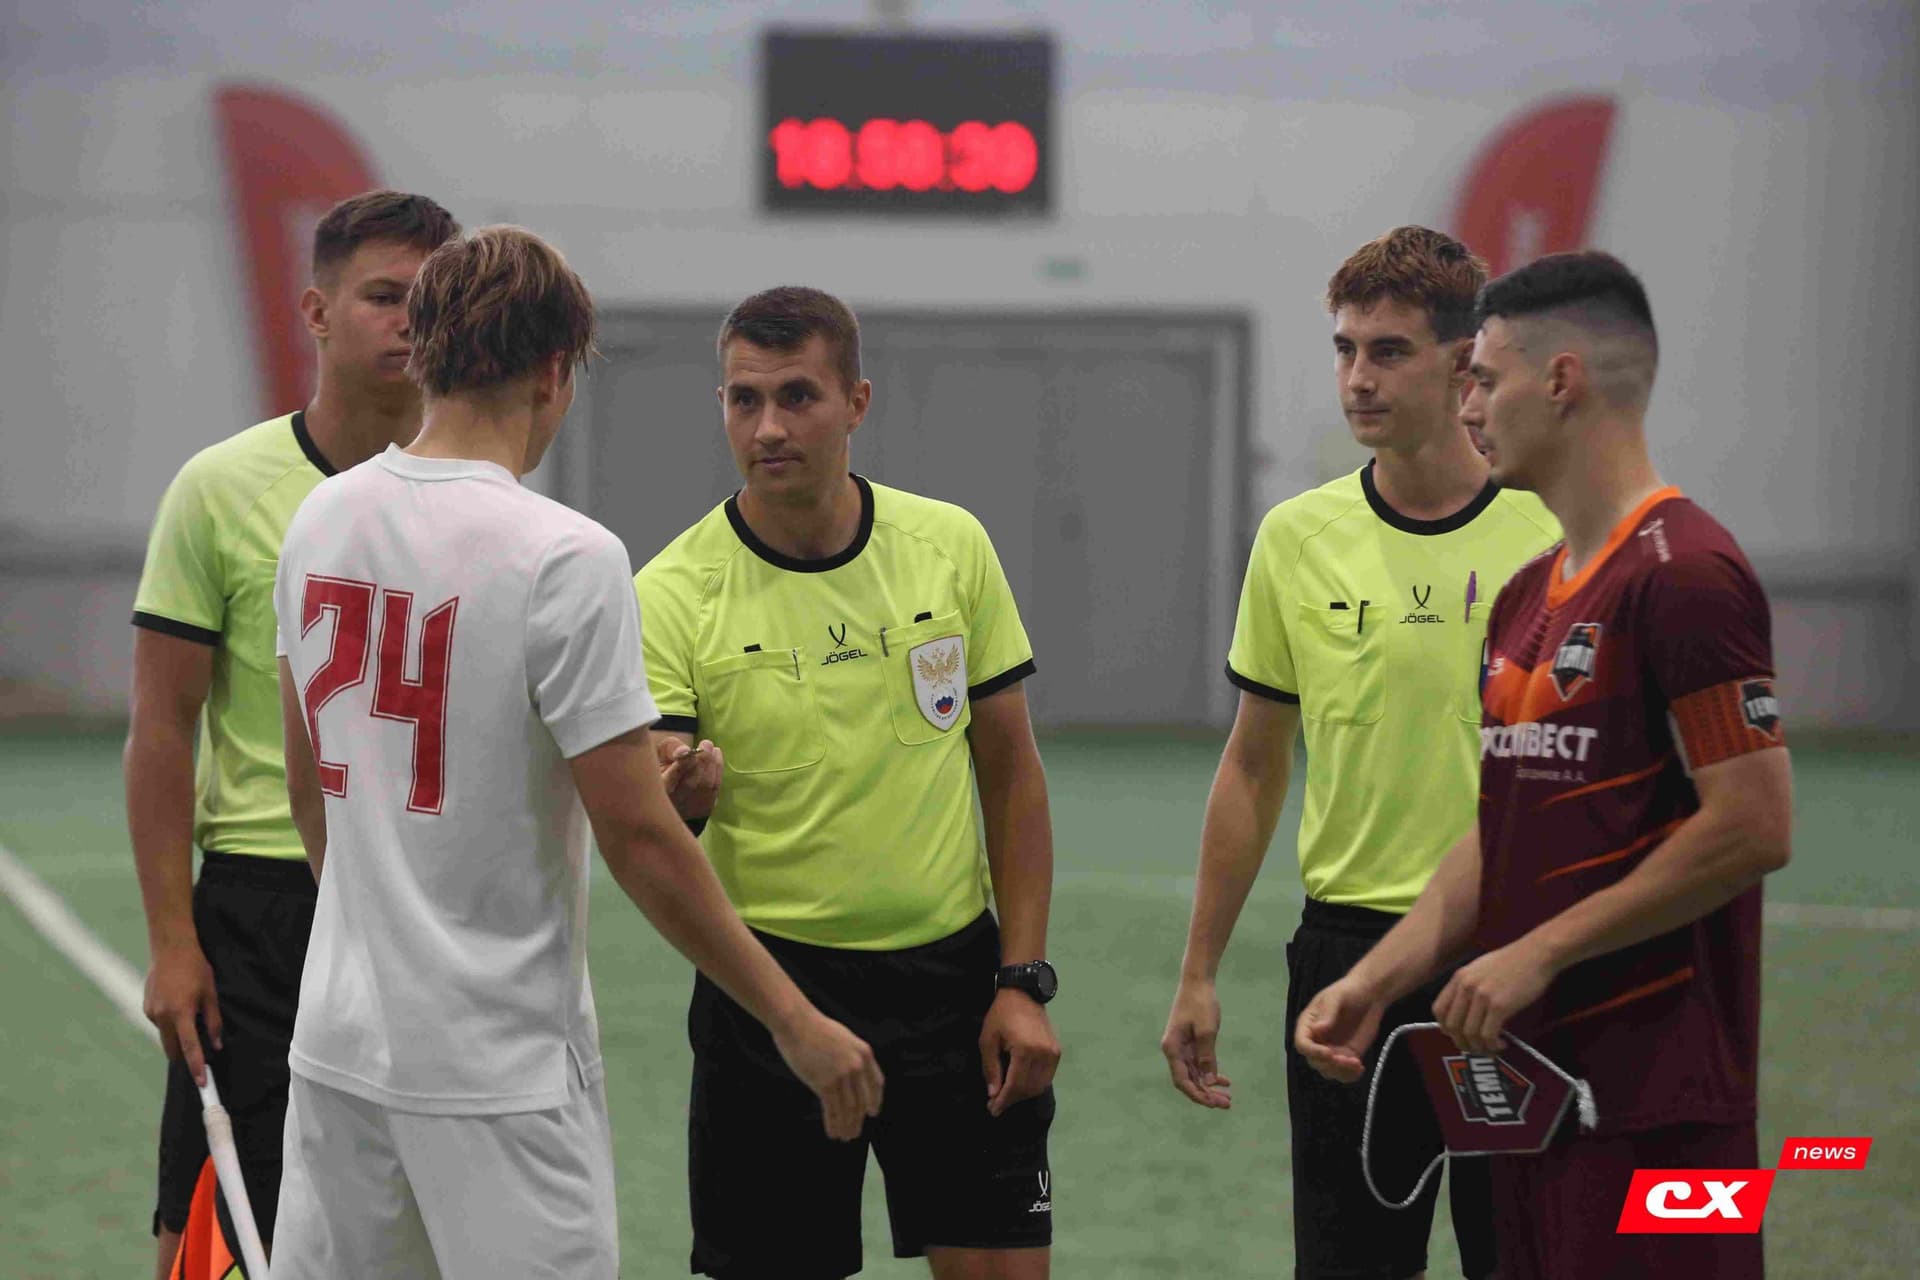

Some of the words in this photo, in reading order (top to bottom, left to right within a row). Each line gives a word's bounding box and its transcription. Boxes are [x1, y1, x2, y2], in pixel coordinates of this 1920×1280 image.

[1399, 613, 1445, 624] JÖGEL
[821, 648, 868, 666] JÖGEL
[301, 573, 459, 815] 24
